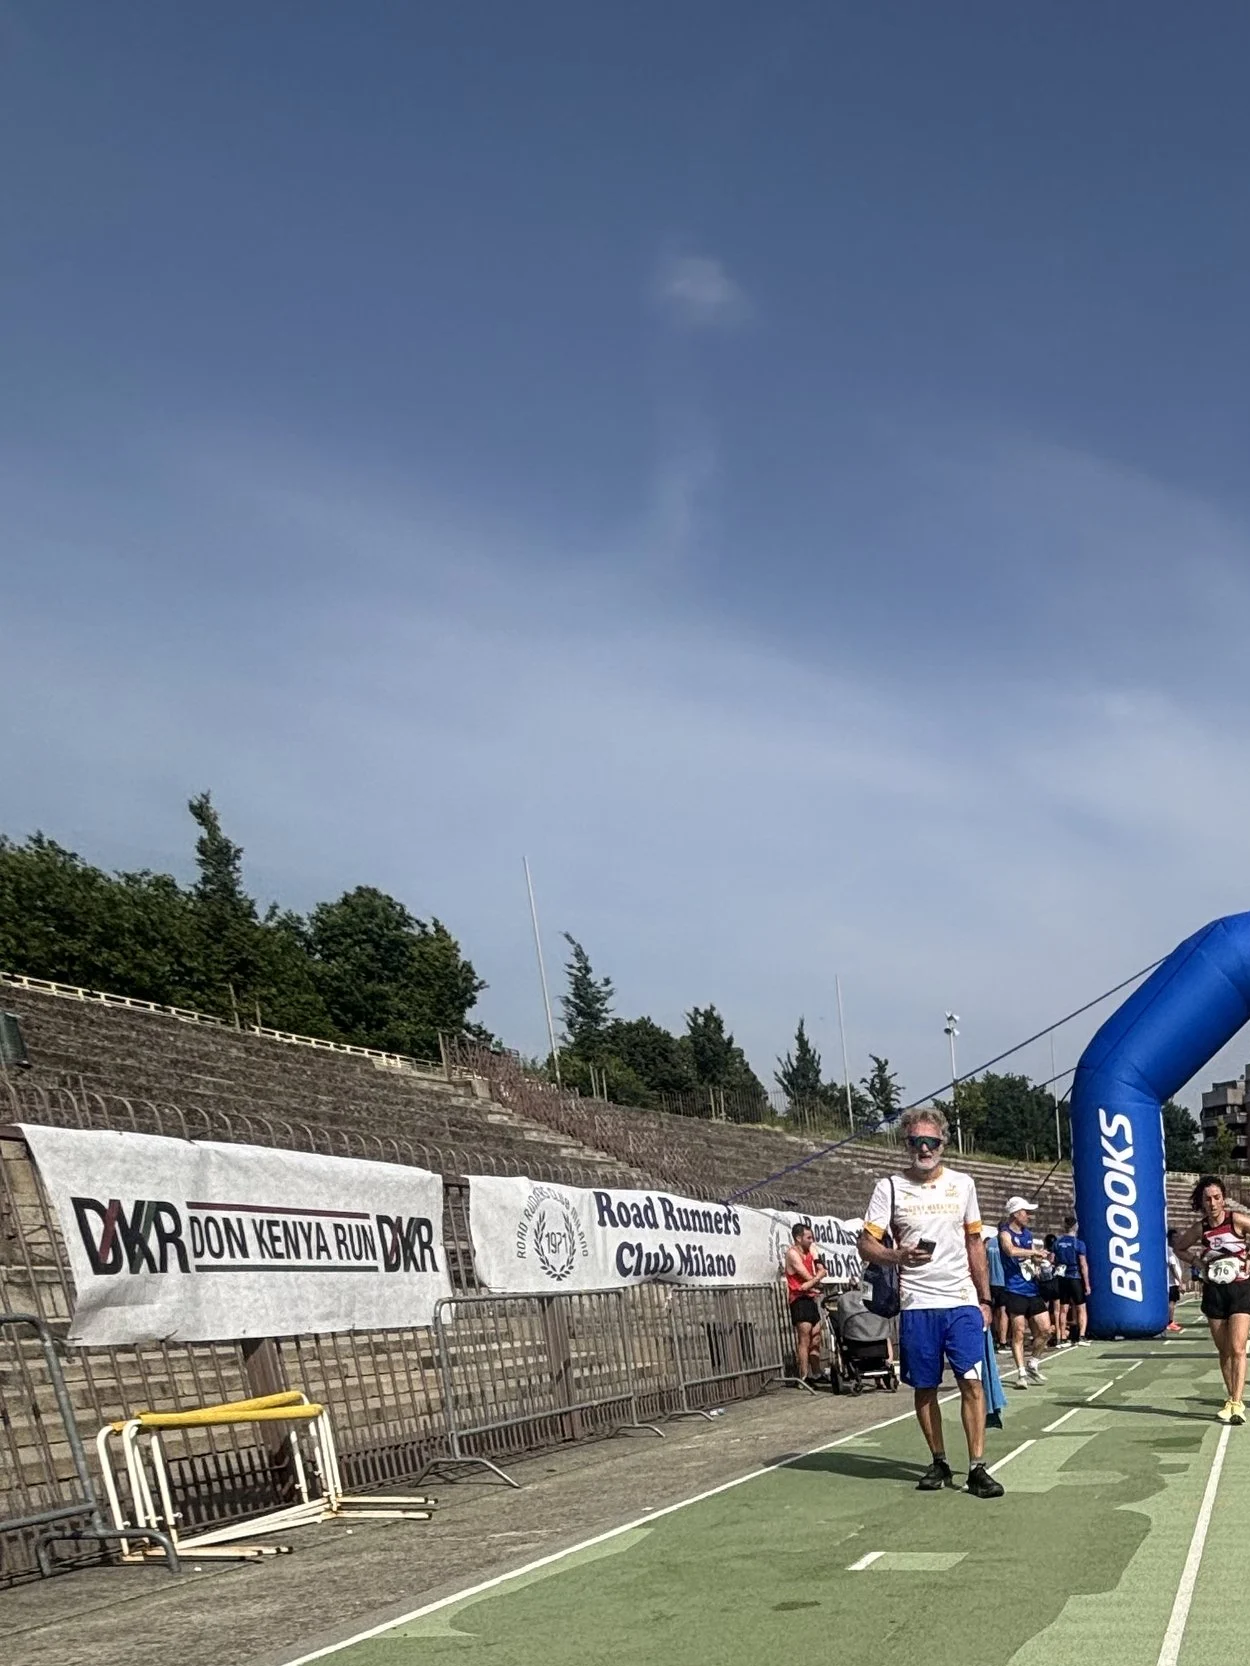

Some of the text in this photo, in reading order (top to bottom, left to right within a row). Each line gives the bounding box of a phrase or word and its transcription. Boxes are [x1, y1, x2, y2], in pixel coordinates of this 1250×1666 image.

[593, 1191, 659, 1230] Road
[1098, 1108, 1143, 1303] BROOKS
[70, 1196, 192, 1276] DKR
[189, 1215, 378, 1261] DON KENYA RUN
[375, 1214, 440, 1273] DKR
[545, 1231, 568, 1255] 1971
[615, 1241, 736, 1278] Club Milano
